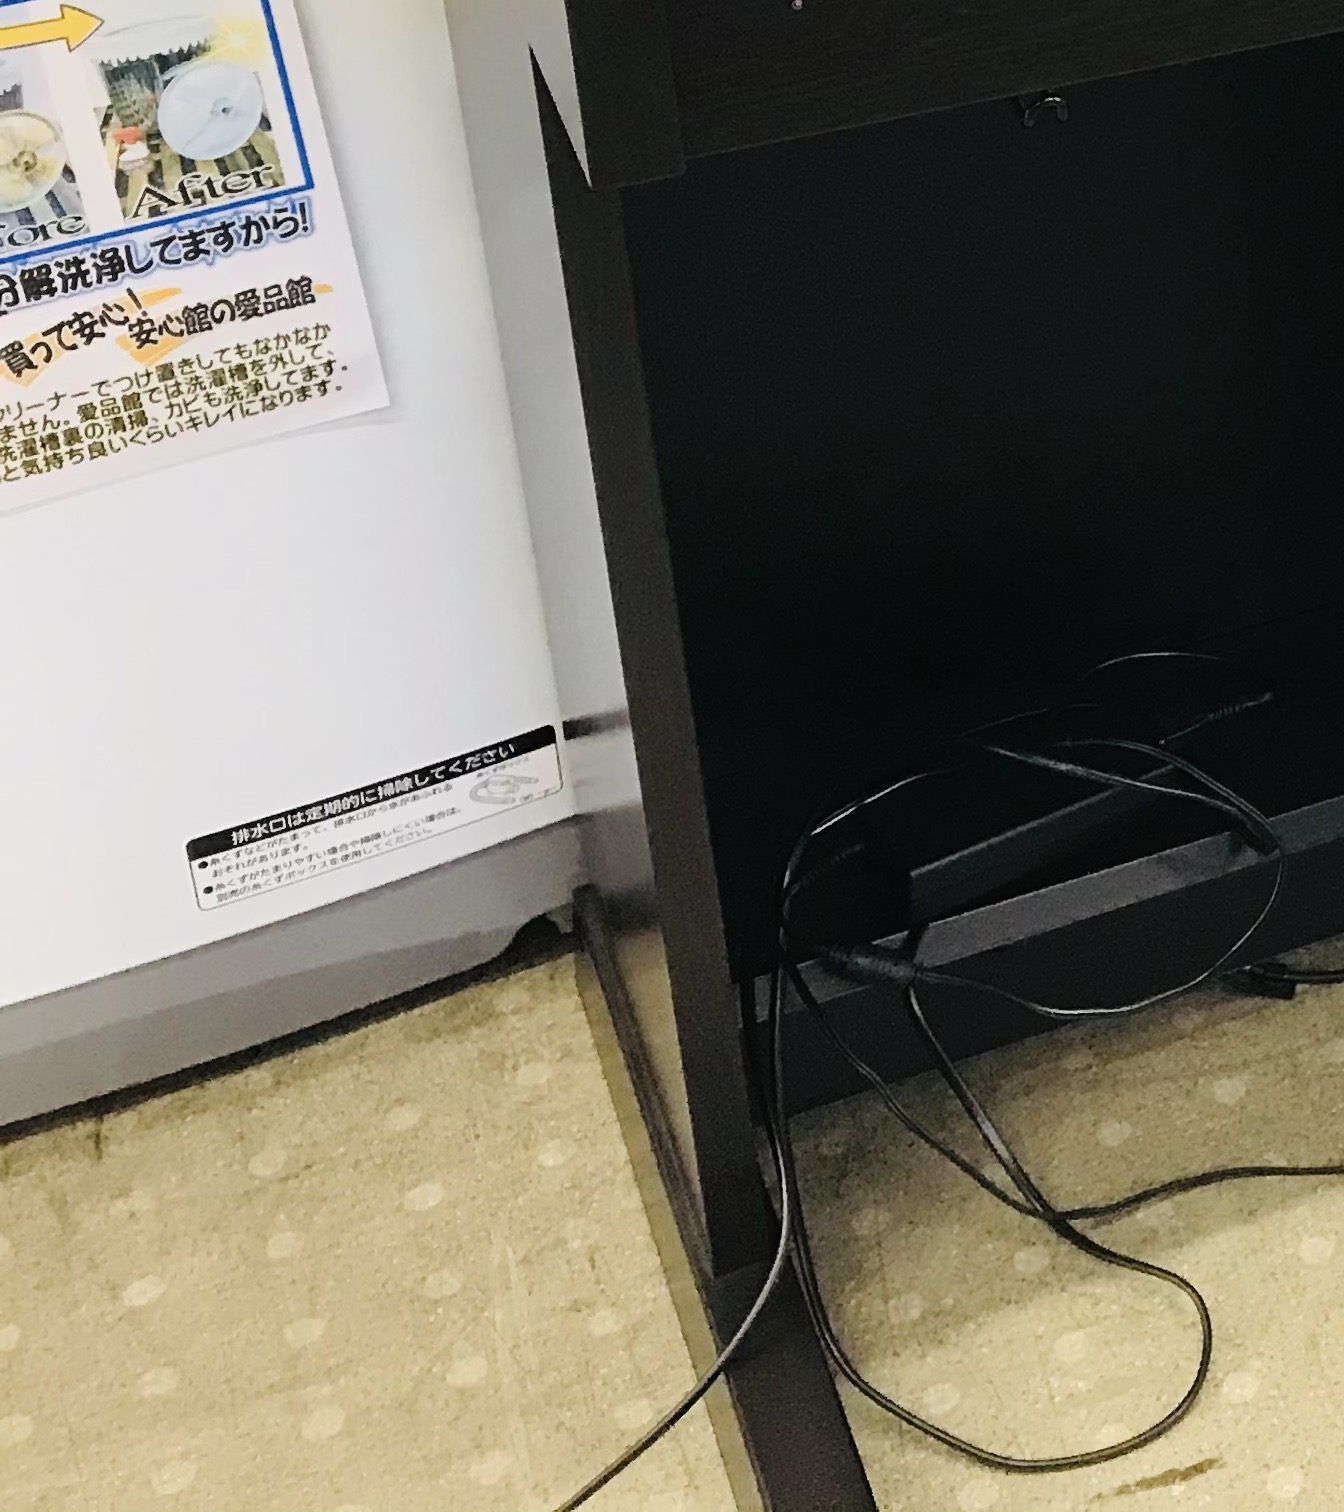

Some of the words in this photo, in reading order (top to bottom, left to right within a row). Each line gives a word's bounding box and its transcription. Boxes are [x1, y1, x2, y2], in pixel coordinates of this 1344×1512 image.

[0, 214, 87, 248] ore
[128, 162, 274, 220] After
[127, 275, 317, 349] 安心館の愛品館
[230, 742, 516, 847] 排水口は定期的に掃除してください
